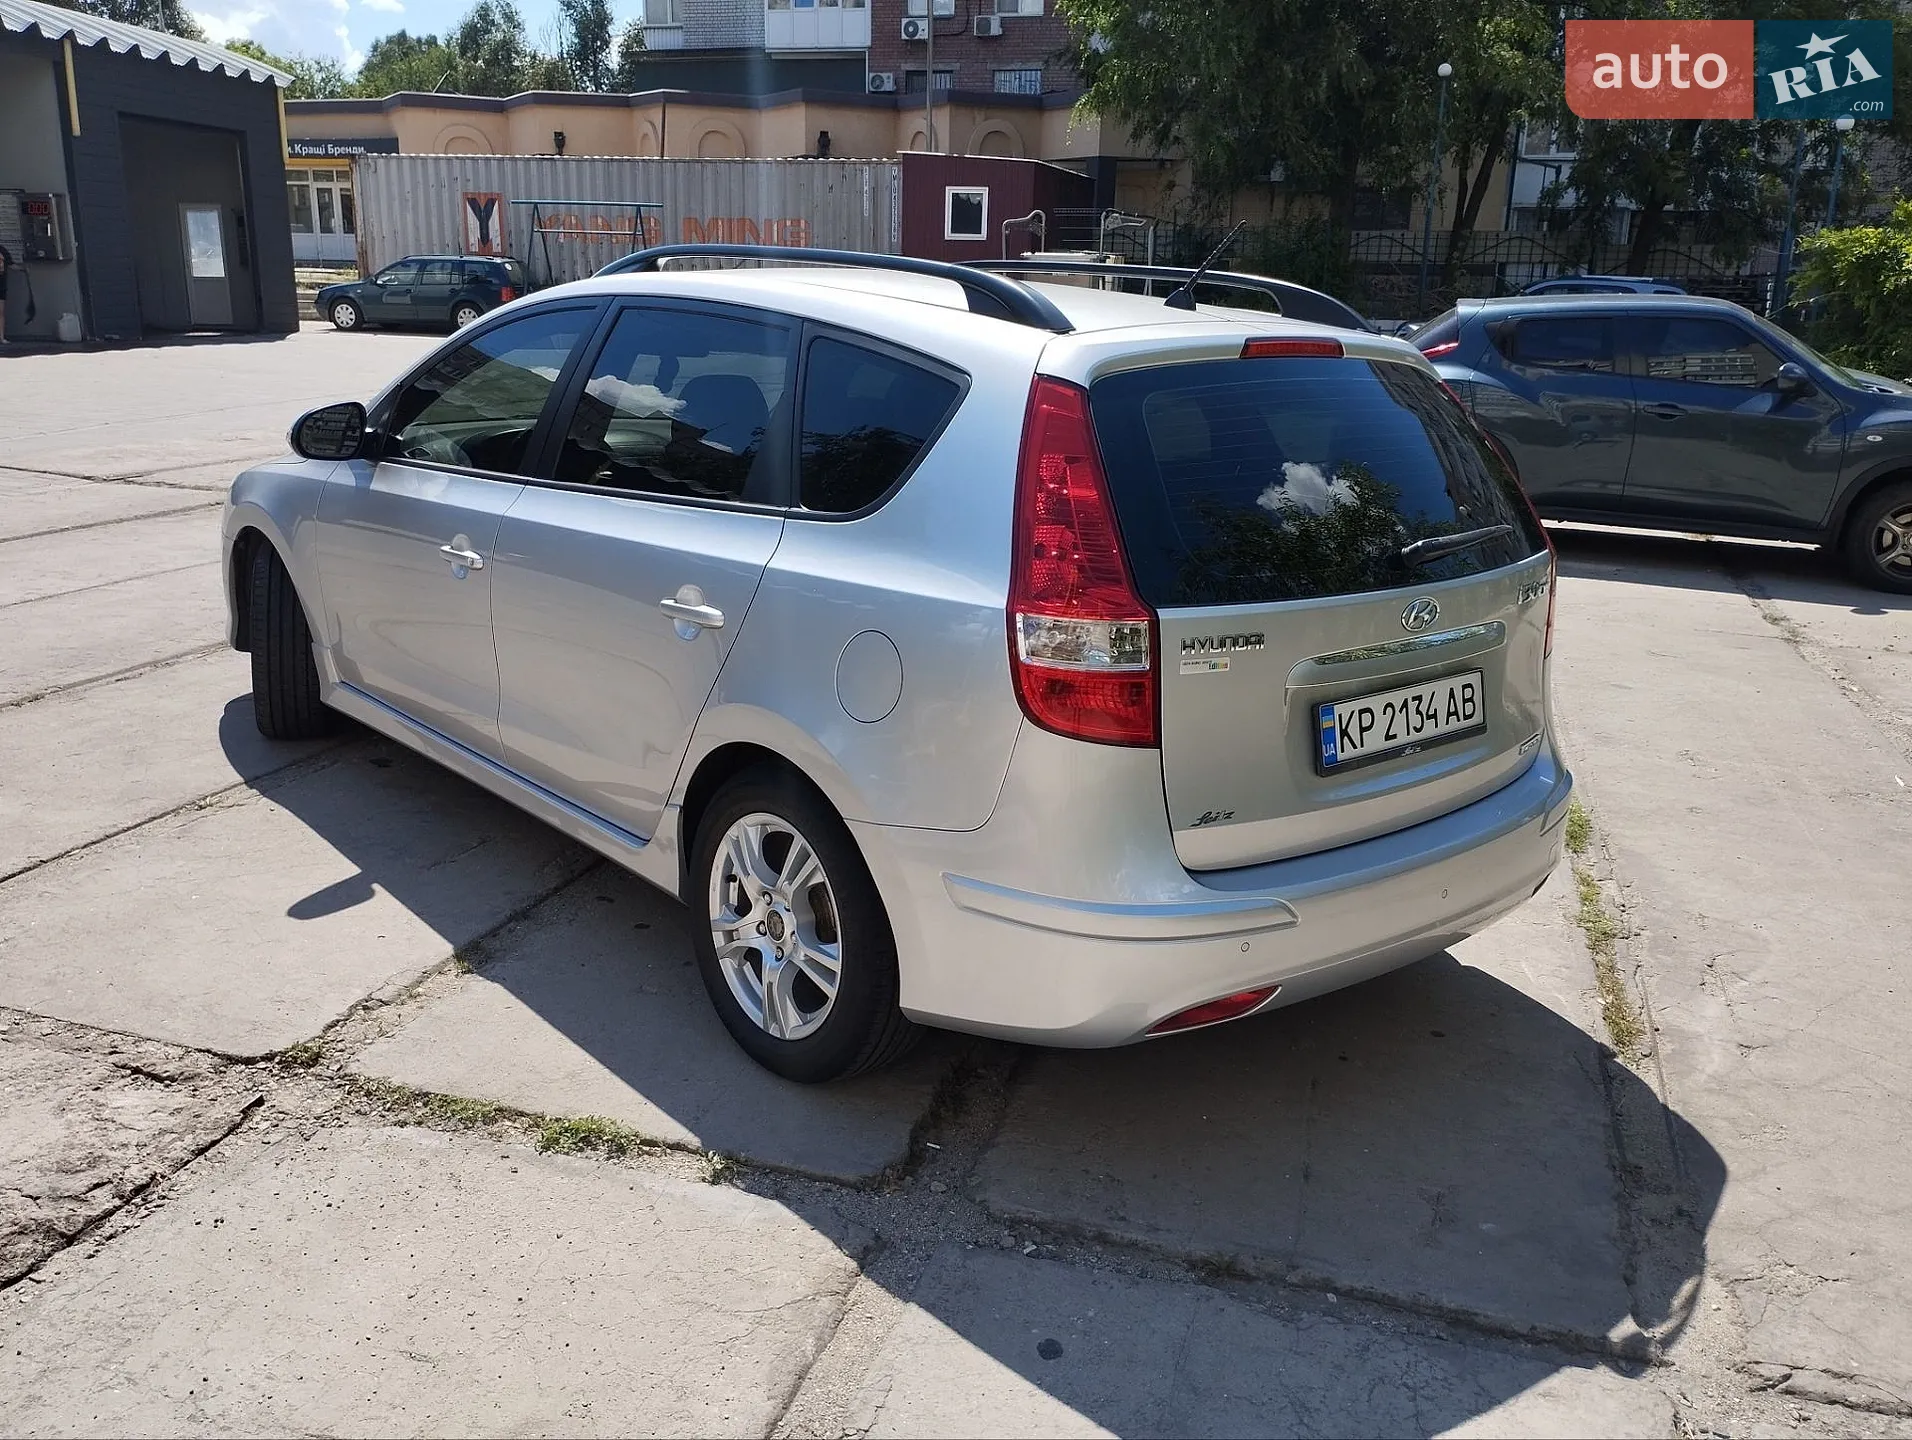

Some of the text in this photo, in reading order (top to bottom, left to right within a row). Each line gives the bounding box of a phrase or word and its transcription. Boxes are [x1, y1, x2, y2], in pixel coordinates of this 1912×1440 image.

[294, 144, 326, 156] Кращі
[327, 144, 367, 156] Бренди.
[682, 216, 812, 247] MING
[1181, 632, 1265, 655] HYUNDAI
[1337, 682, 1476, 753] KP 2134 AB
[1323, 743, 1336, 757] UA
